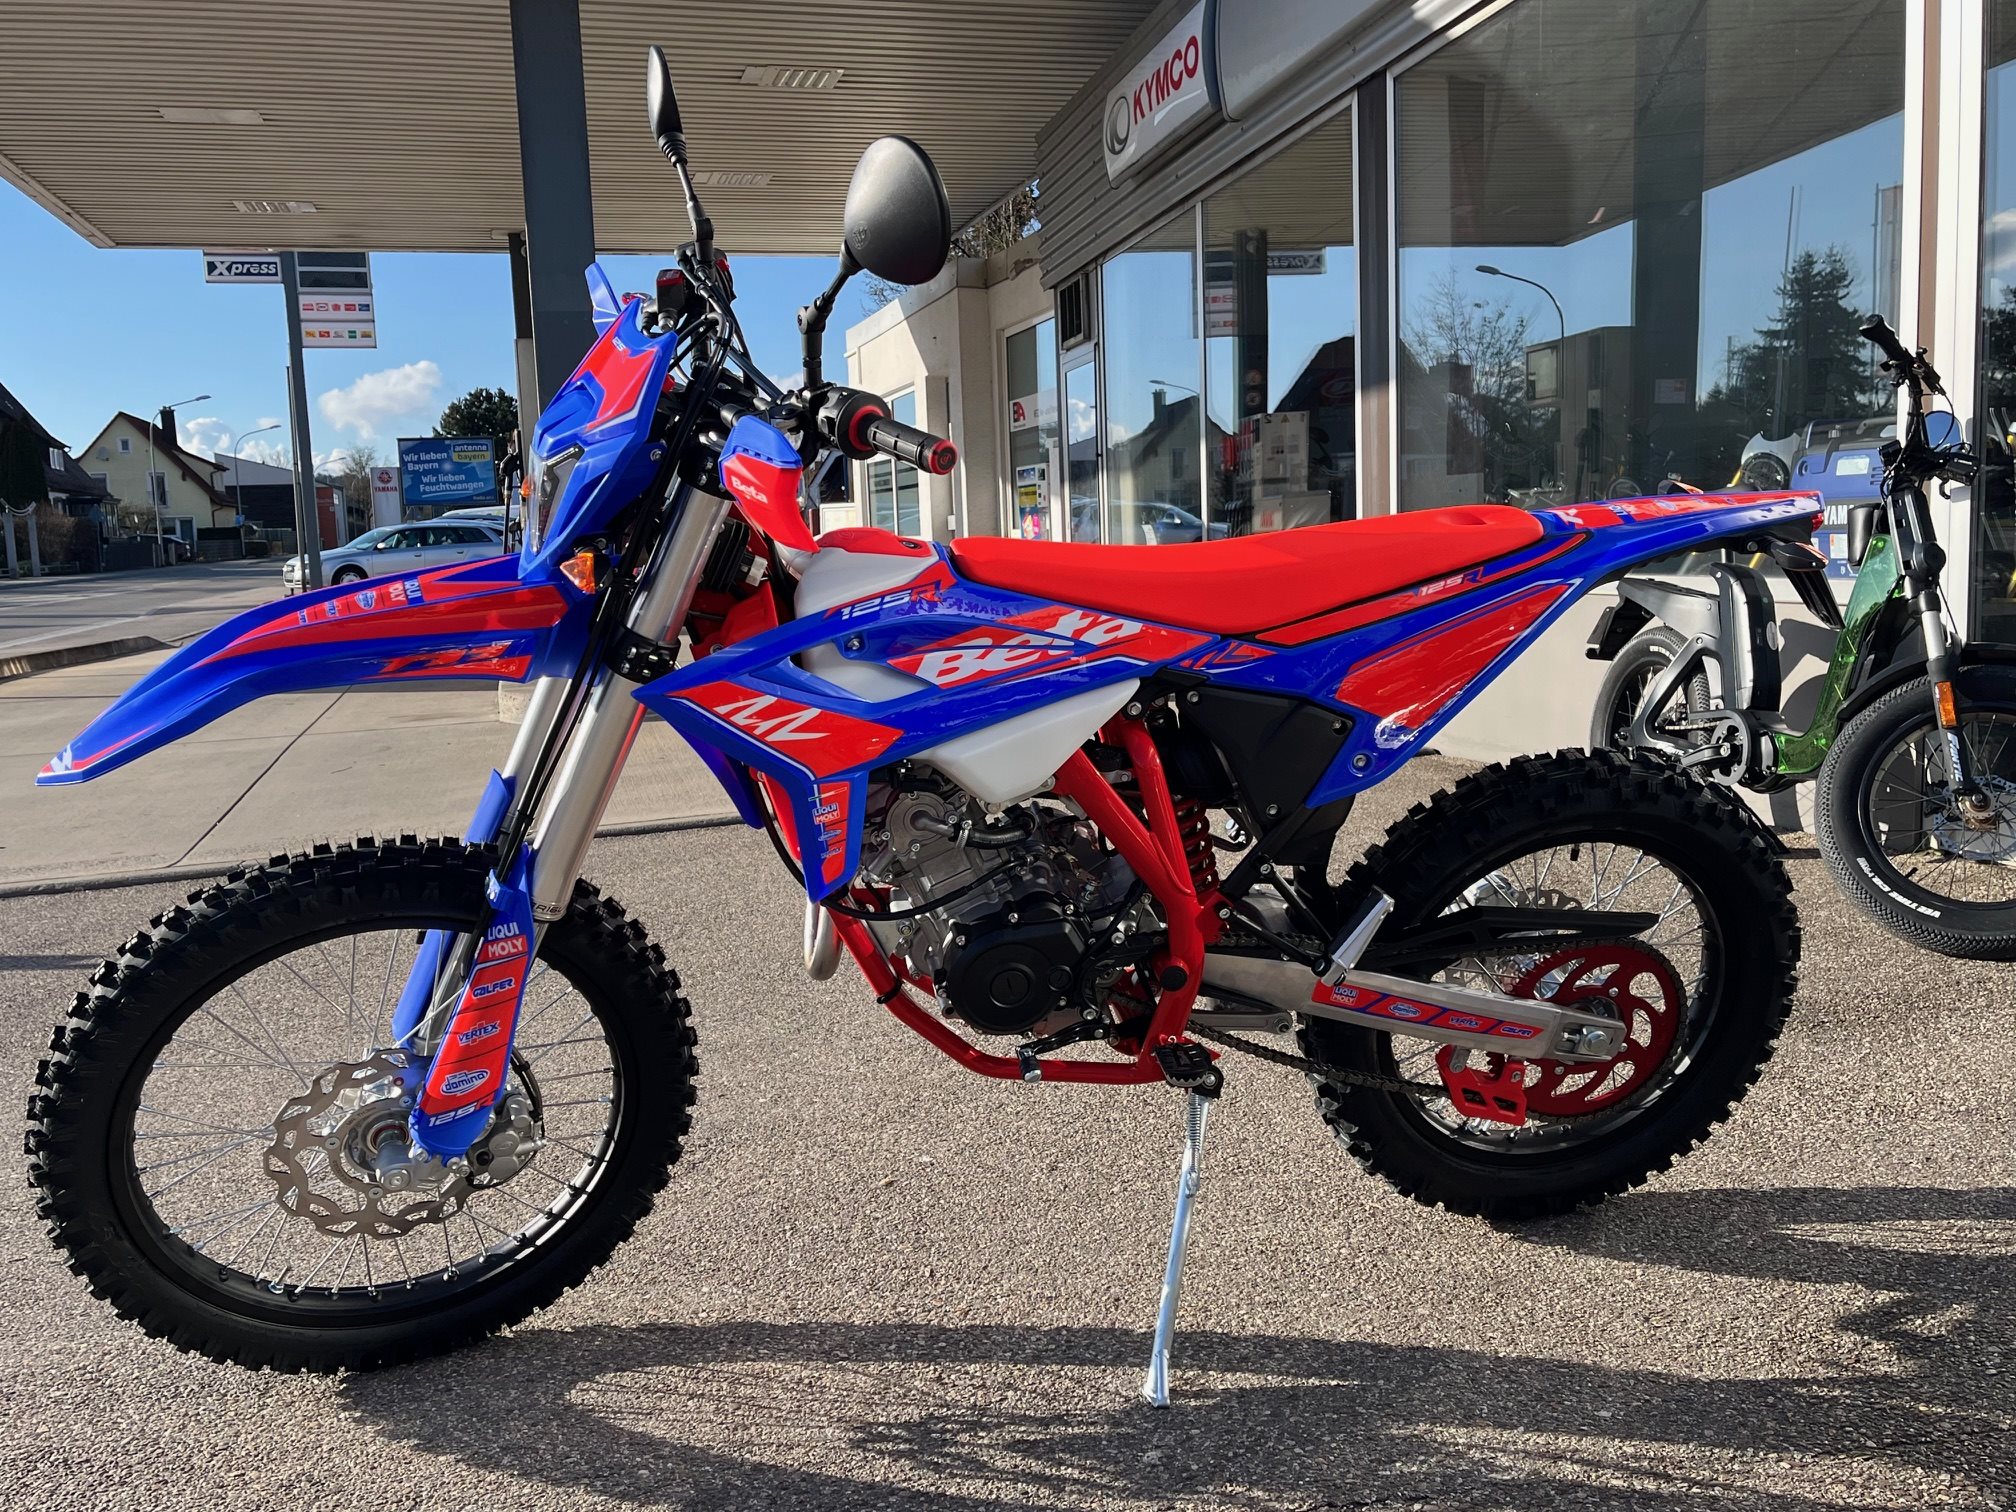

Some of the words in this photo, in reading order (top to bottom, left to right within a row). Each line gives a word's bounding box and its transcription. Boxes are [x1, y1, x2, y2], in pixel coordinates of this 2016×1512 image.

[1133, 35, 1199, 125] KYMCO
[208, 261, 277, 276] Xpress
[454, 444, 487, 452] antenne
[403, 453, 419, 462] Wir
[420, 452, 447, 461] lieben
[457, 452, 486, 461] bayern
[407, 462, 439, 472] Bayern
[421, 475, 437, 483] Wir
[438, 473, 465, 482] lieben
[420, 481, 484, 492] Feuchtwangen
[730, 474, 769, 504] Beta
[915, 609, 1143, 686] Beta
[814, 803, 838, 816] LIQUI
[816, 810, 840, 823] MOLY
[488, 922, 519, 940] LIQUI
[488, 938, 523, 957] MOLY
[1335, 986, 1357, 996] LIQUI
[1333, 994, 1355, 1004] MOLY
[457, 1022, 500, 1043] VERTEX
[444, 1073, 485, 1092] domino
